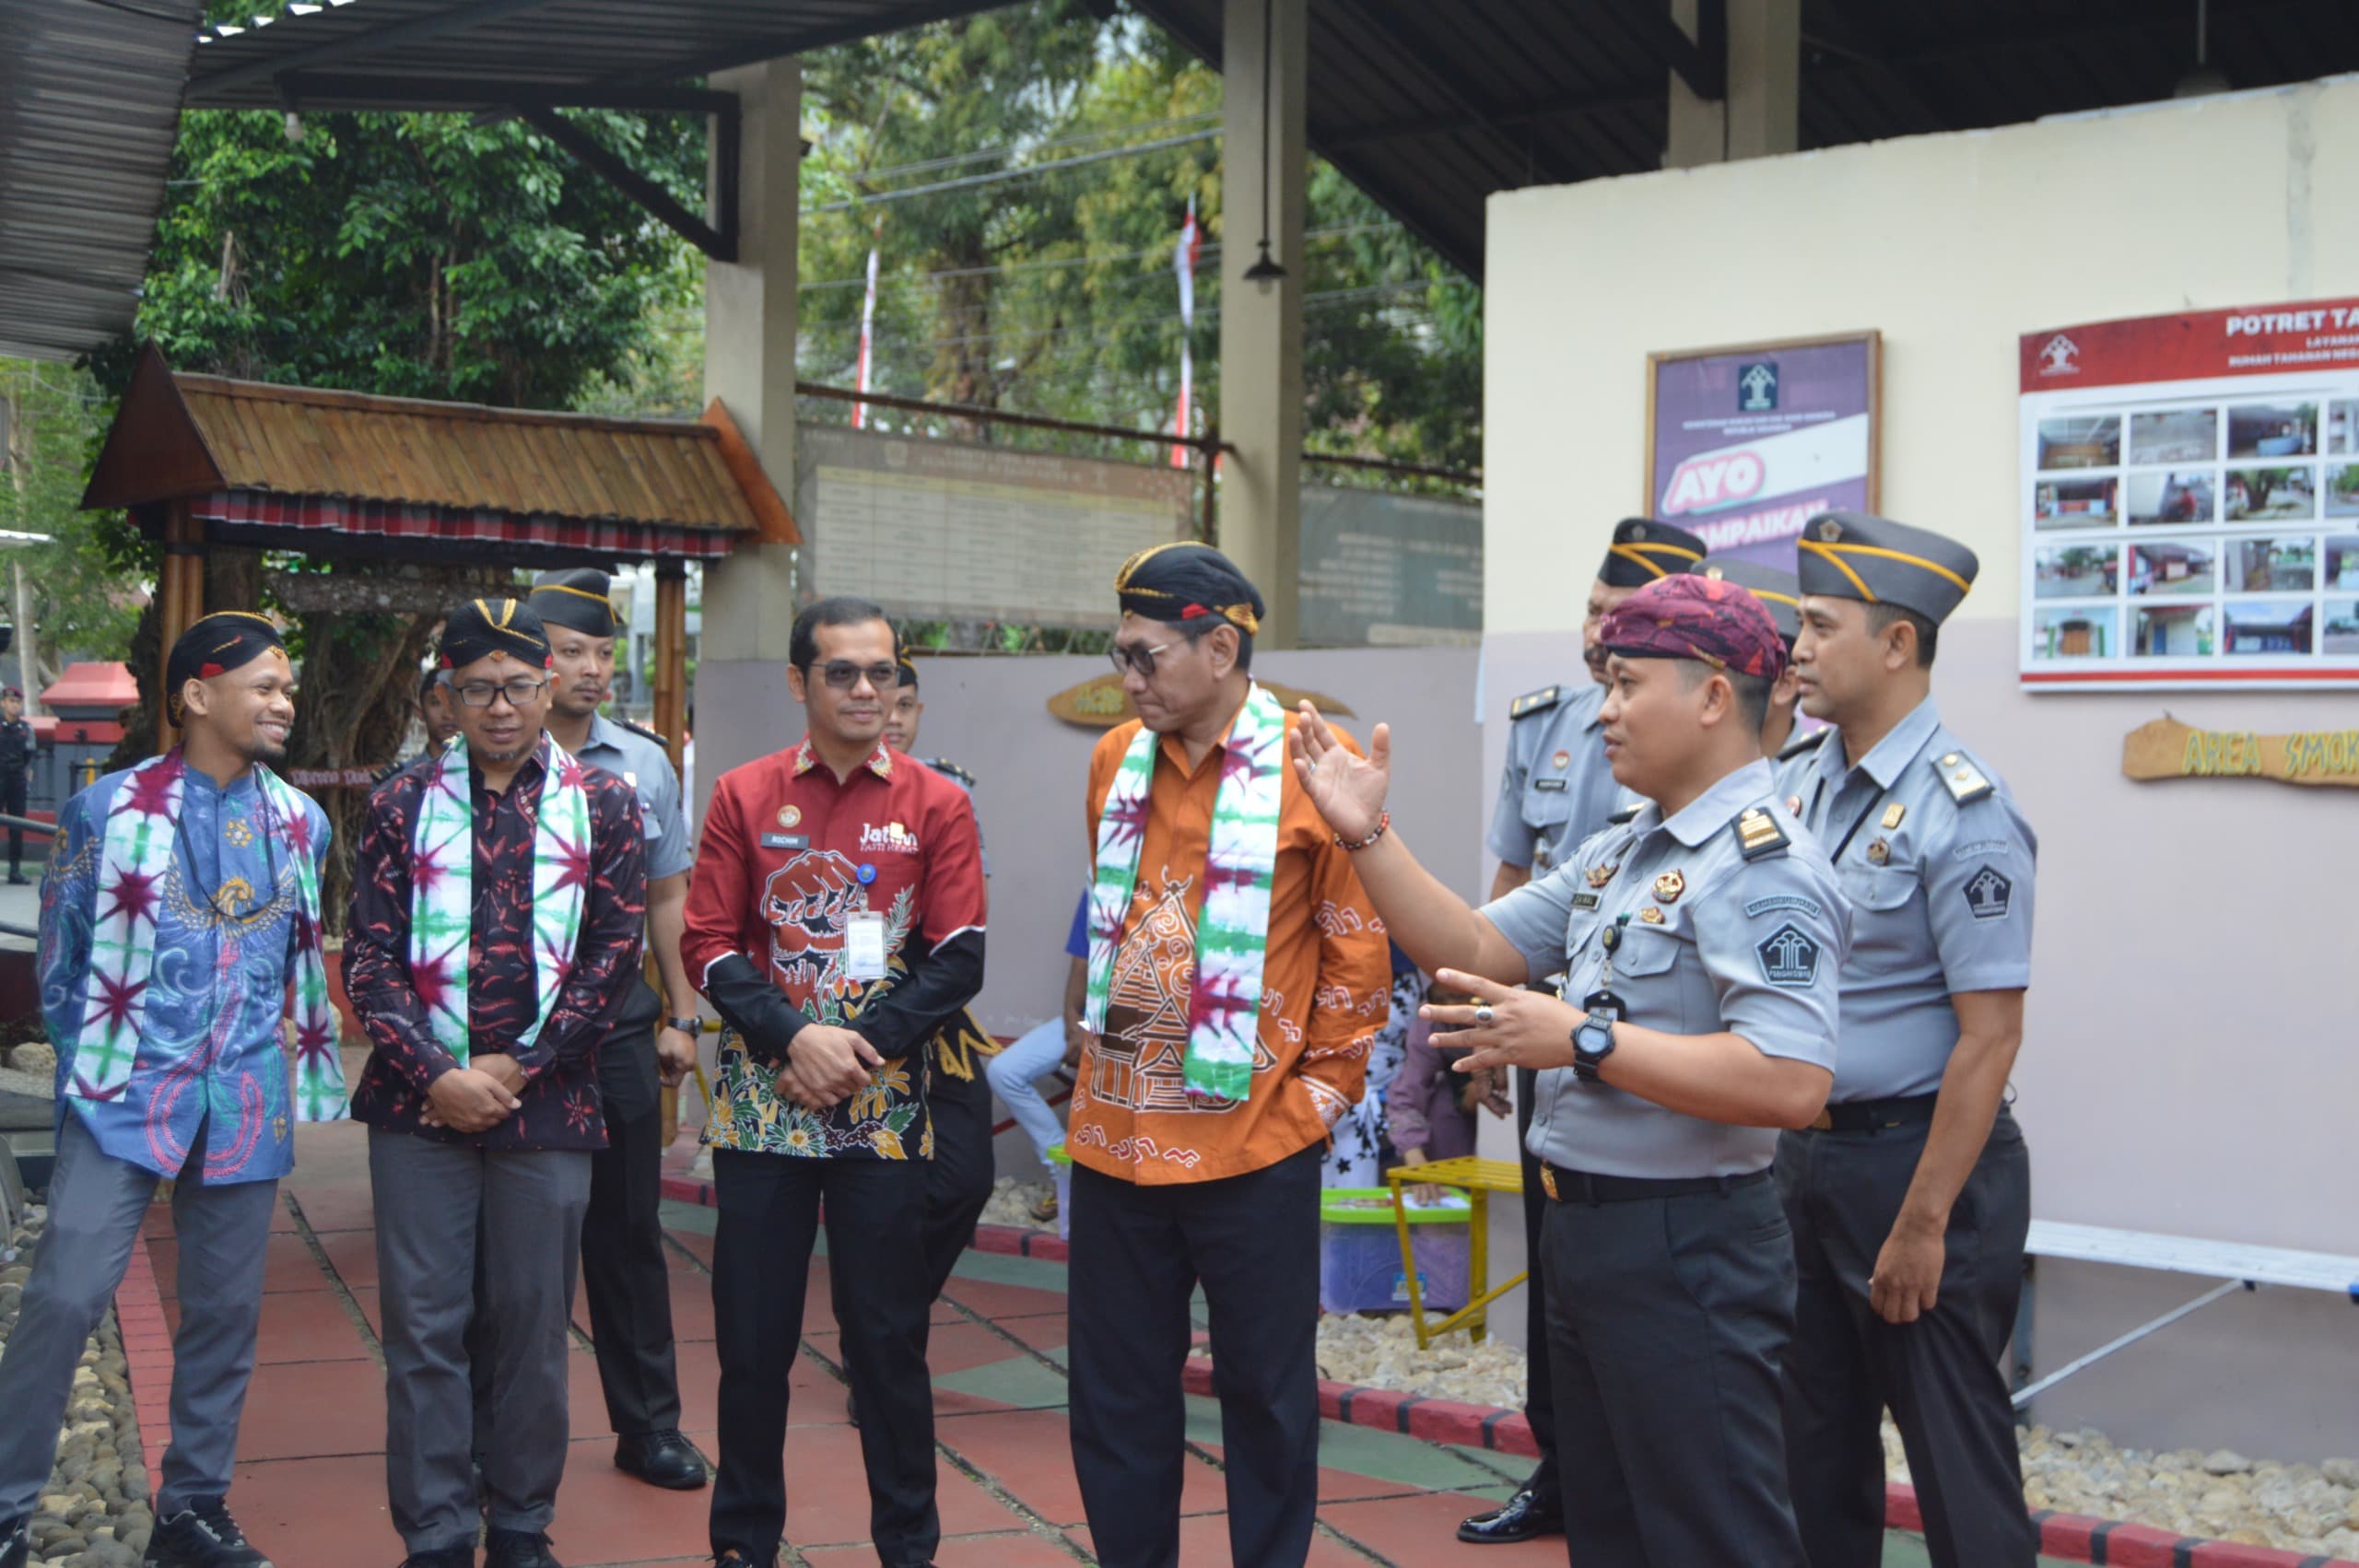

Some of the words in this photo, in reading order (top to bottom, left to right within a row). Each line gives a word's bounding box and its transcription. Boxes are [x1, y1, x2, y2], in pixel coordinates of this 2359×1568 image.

[2226, 311, 2326, 336] POTRET
[1667, 451, 1765, 512] AYO
[2182, 730, 2261, 776] AREA
